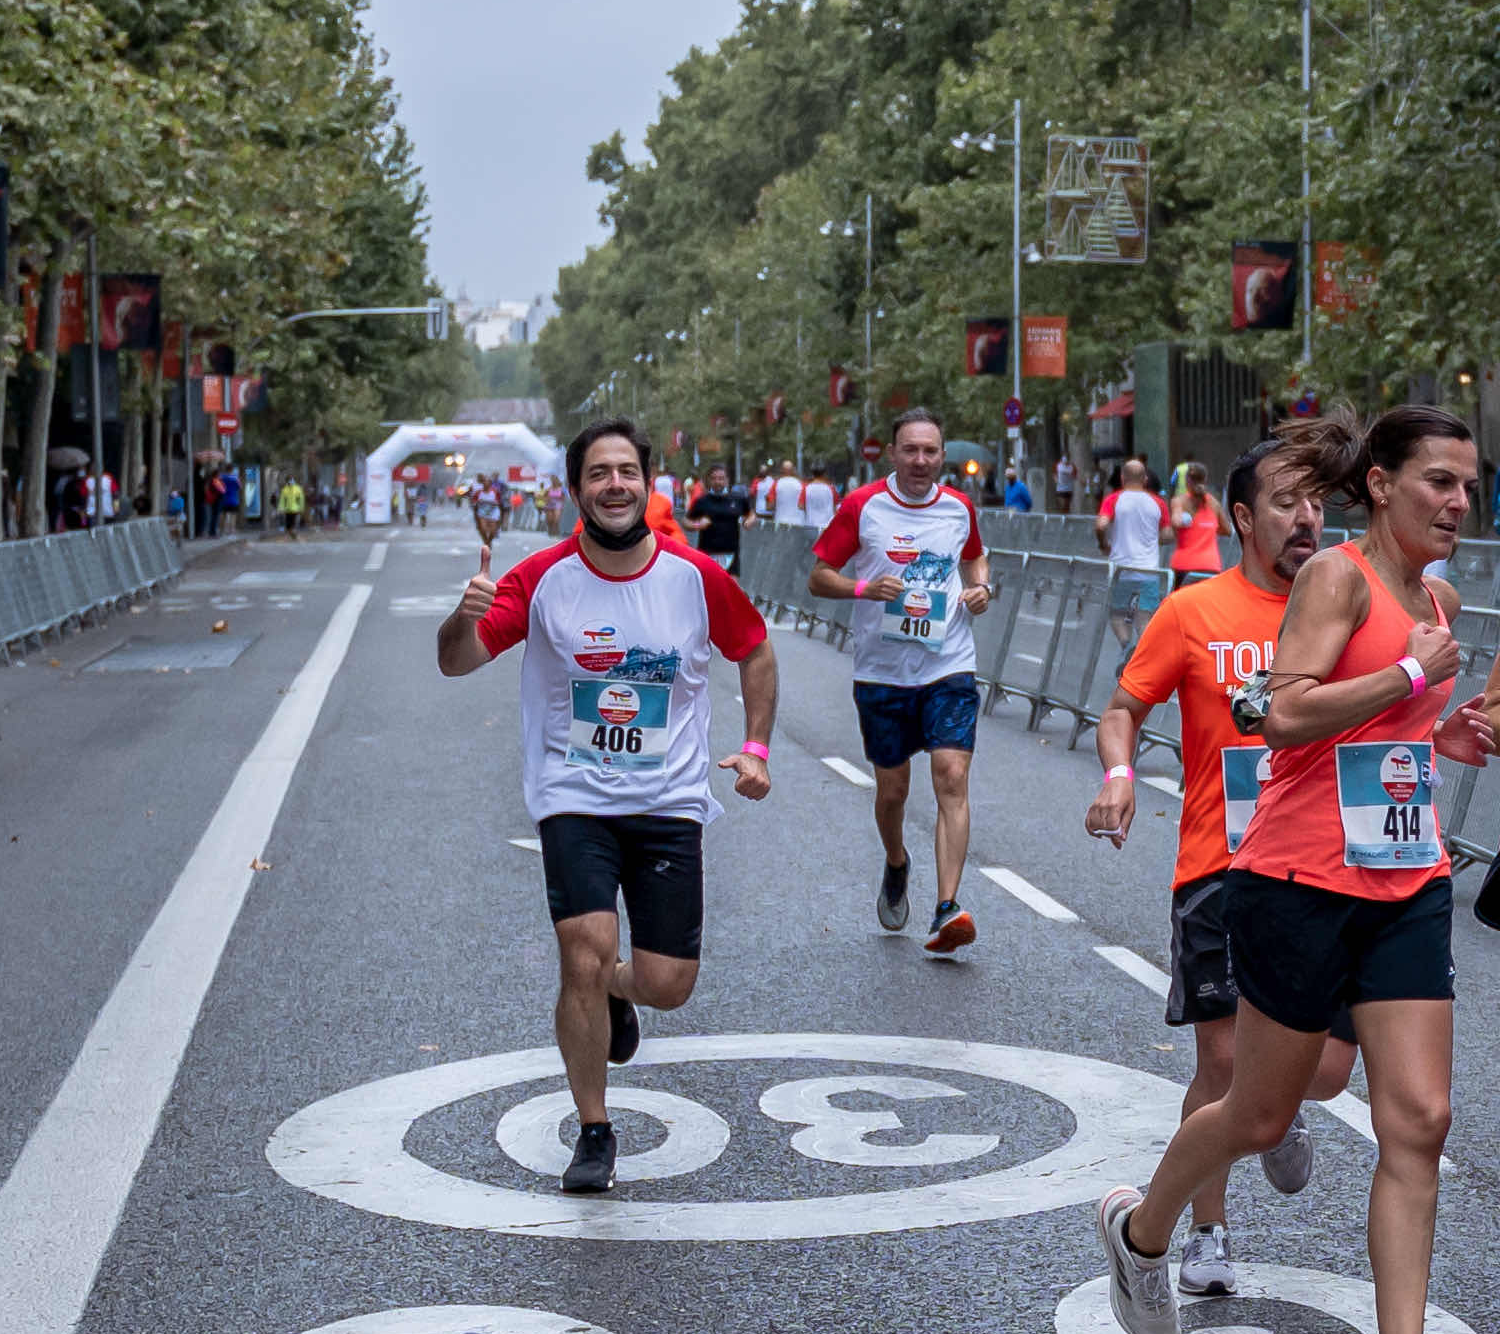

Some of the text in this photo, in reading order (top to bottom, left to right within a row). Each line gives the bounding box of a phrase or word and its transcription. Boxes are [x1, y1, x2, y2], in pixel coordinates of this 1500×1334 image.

[900, 617, 931, 638] 410
[591, 725, 643, 754] 406
[1384, 806, 1421, 842] 414
